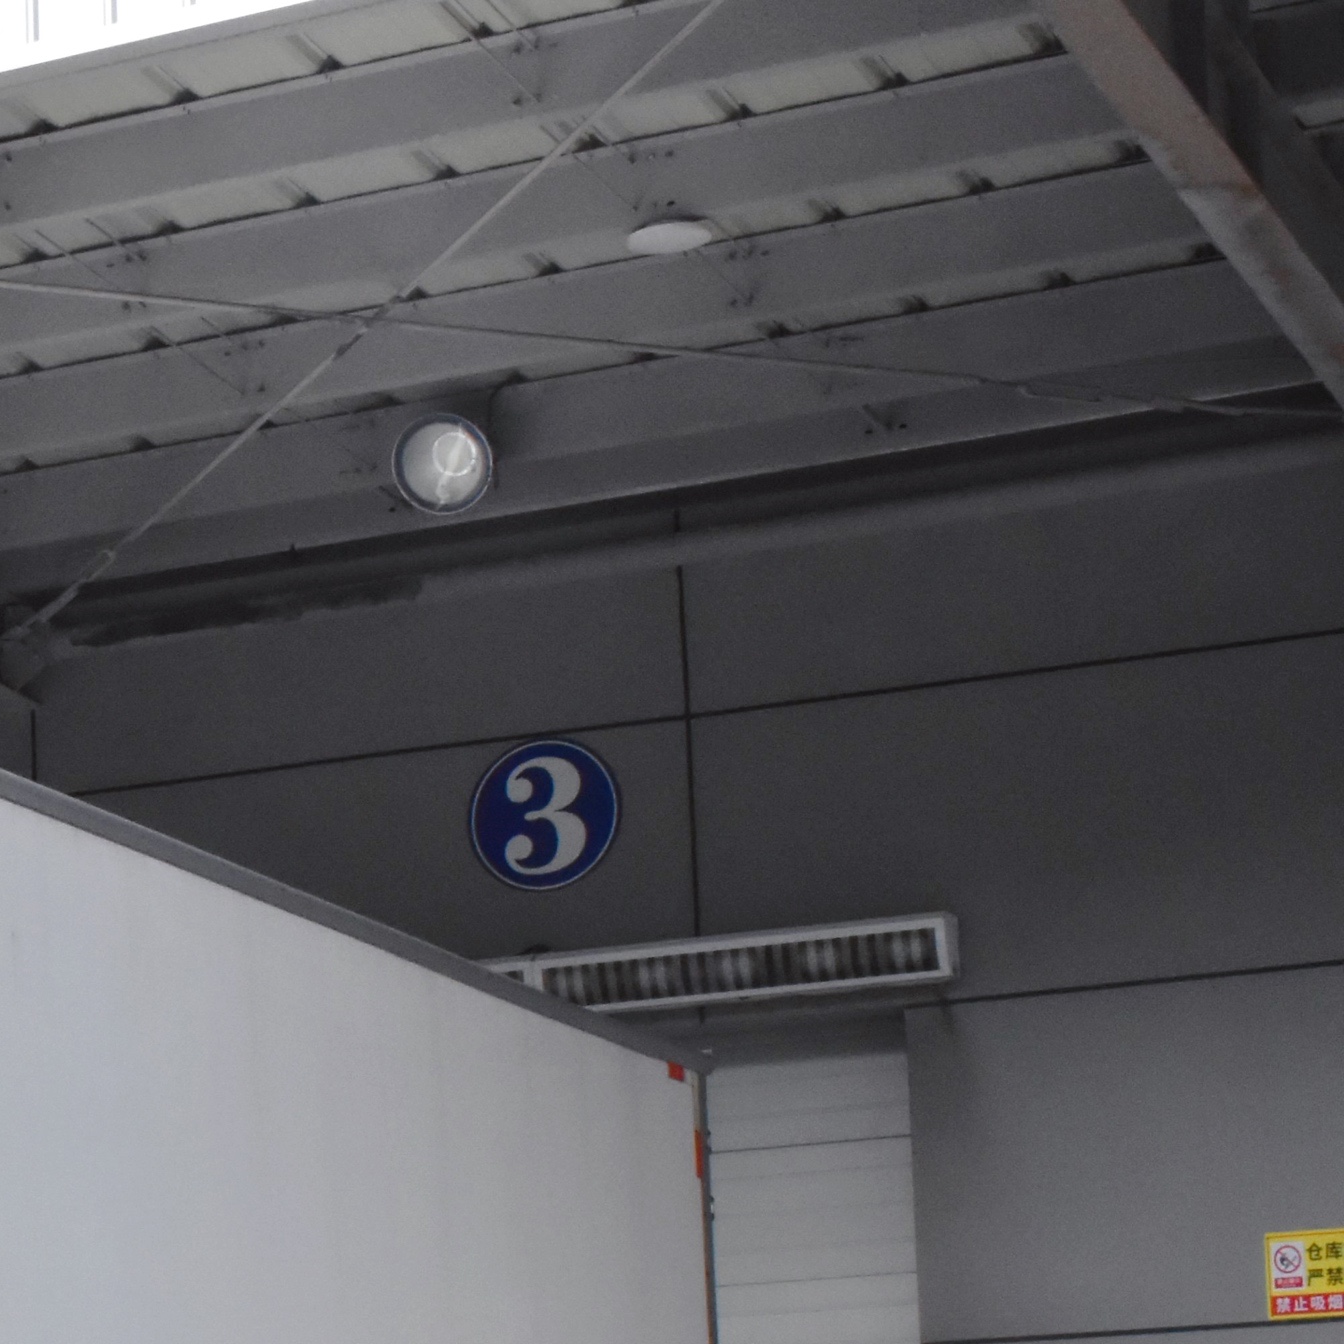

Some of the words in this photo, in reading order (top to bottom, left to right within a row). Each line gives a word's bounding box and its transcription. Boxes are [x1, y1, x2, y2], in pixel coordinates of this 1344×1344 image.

[505, 756, 587, 876] 3
[1306, 1241, 1343, 1261] 仓库
[1307, 1267, 1344, 1287] 严禁
